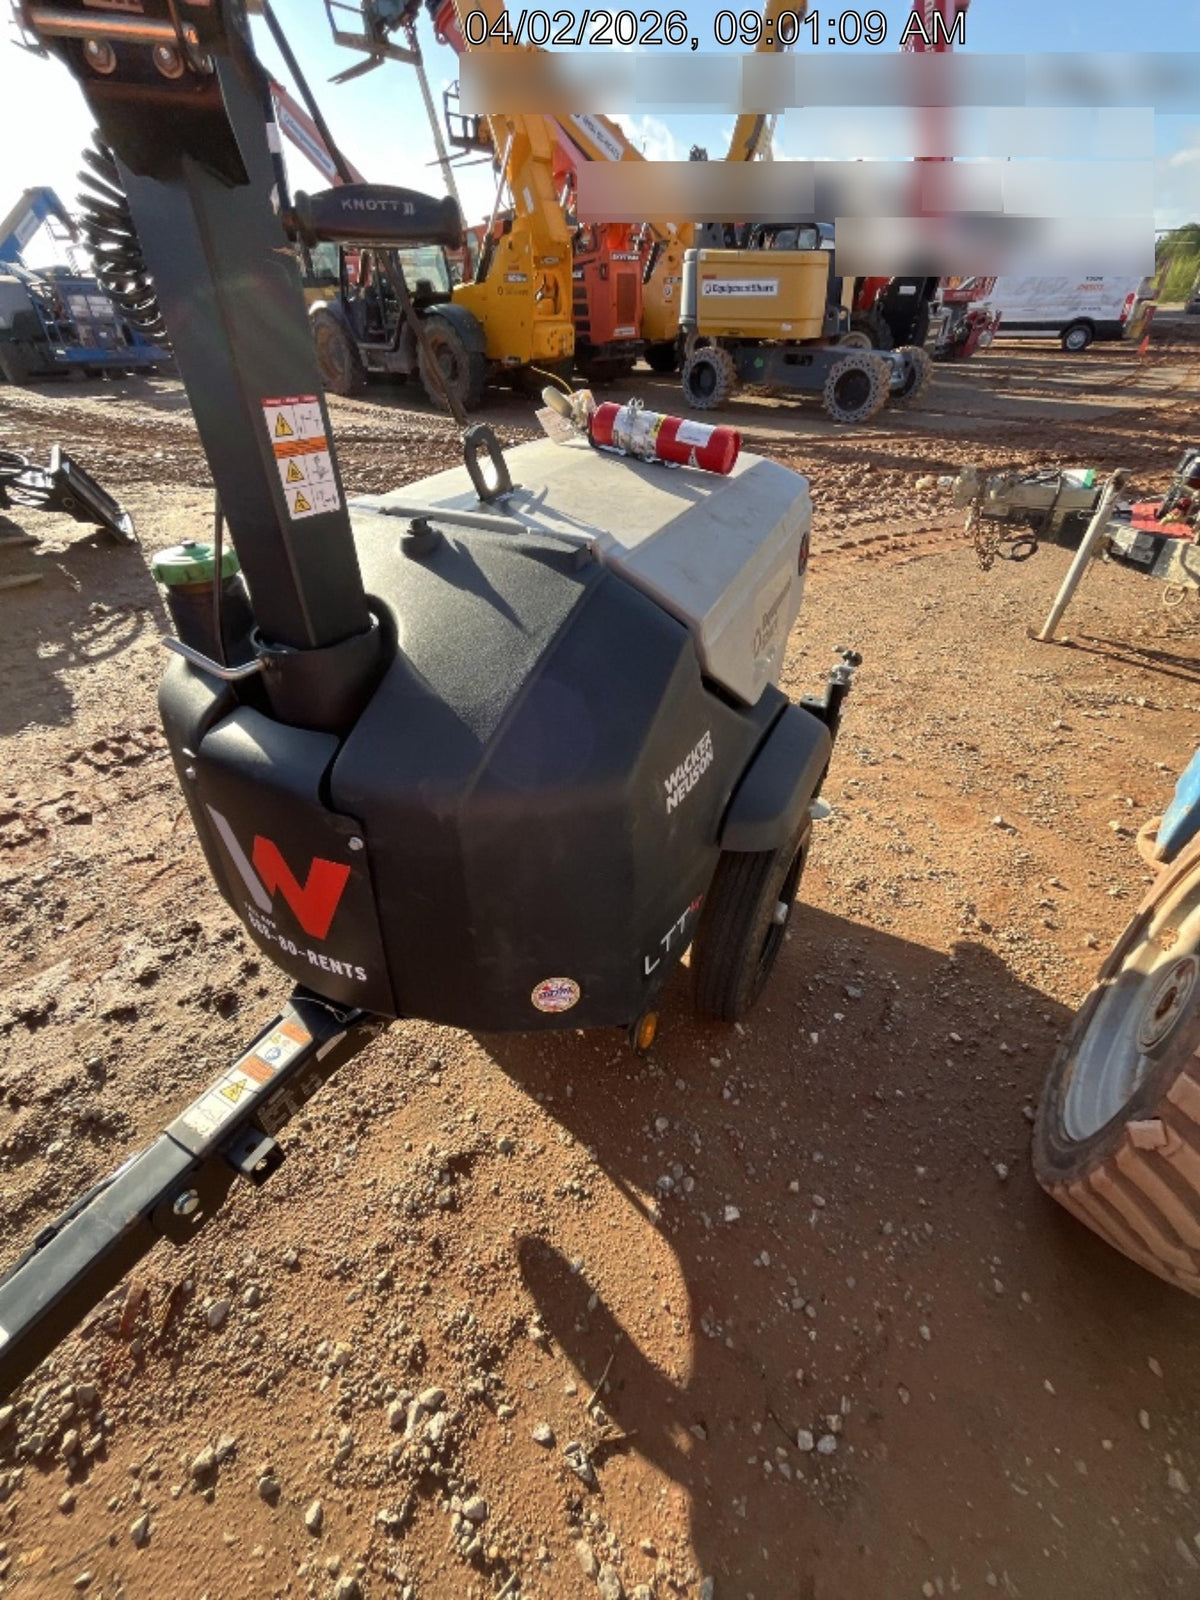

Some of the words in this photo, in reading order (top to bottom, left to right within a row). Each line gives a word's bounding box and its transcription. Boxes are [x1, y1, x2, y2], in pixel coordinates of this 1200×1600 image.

[341, 199, 400, 211] KNOTT
[664, 730, 712, 794] WACKER
[666, 750, 714, 814] NEUSON
